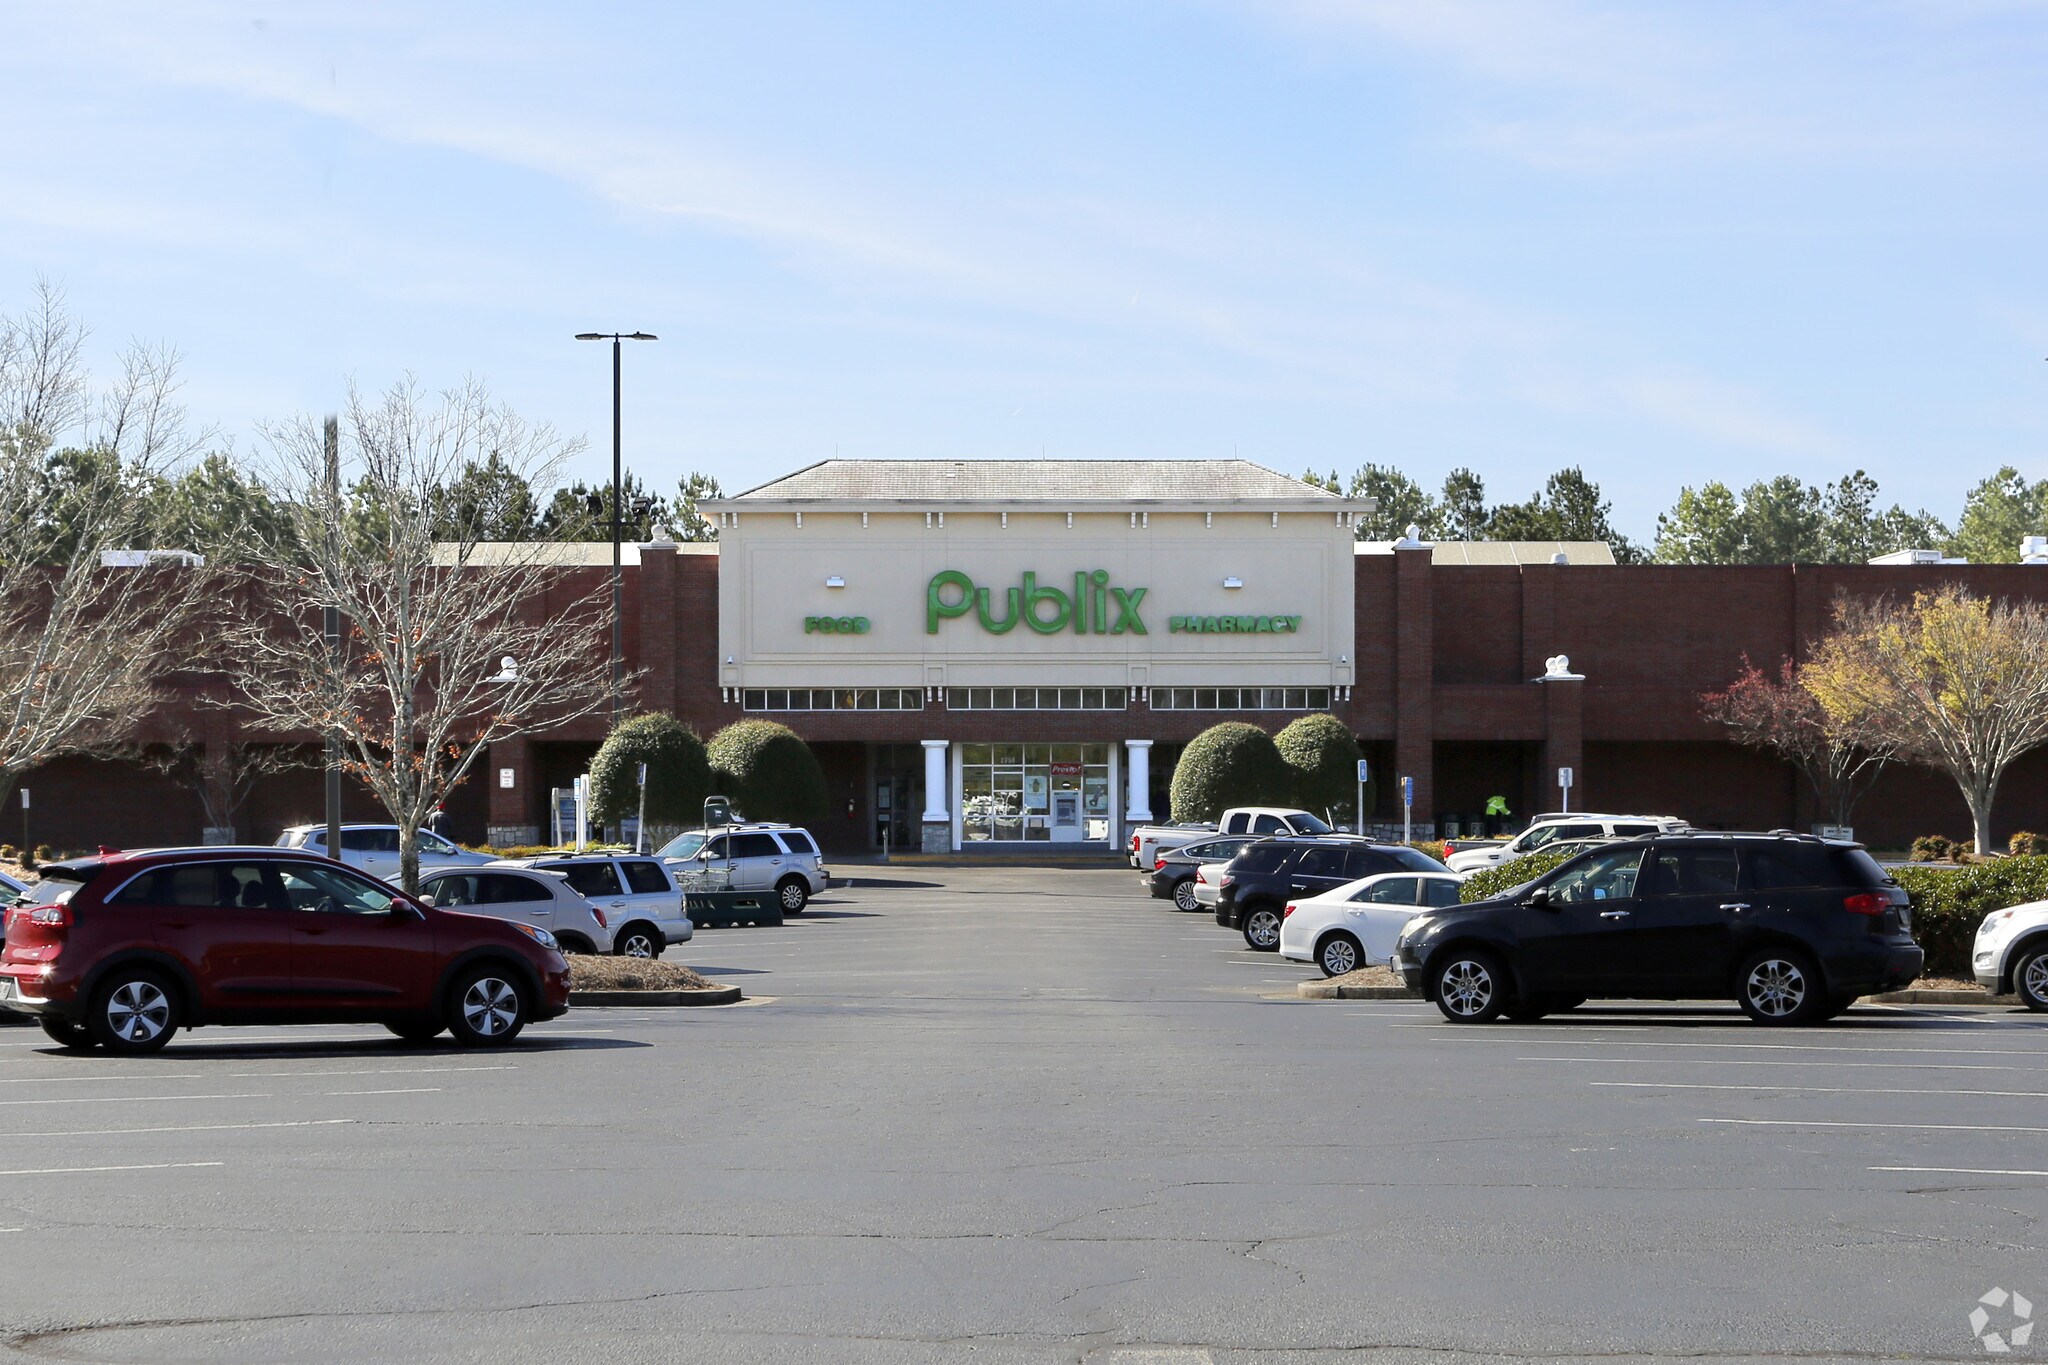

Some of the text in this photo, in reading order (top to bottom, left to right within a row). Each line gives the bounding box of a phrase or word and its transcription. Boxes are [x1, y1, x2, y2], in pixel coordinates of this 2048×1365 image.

[926, 569, 1148, 635] Publix
[804, 616, 871, 635] FOOD
[1169, 615, 1303, 634] PHARMACY
[1052, 765, 1081, 774] Presto!
